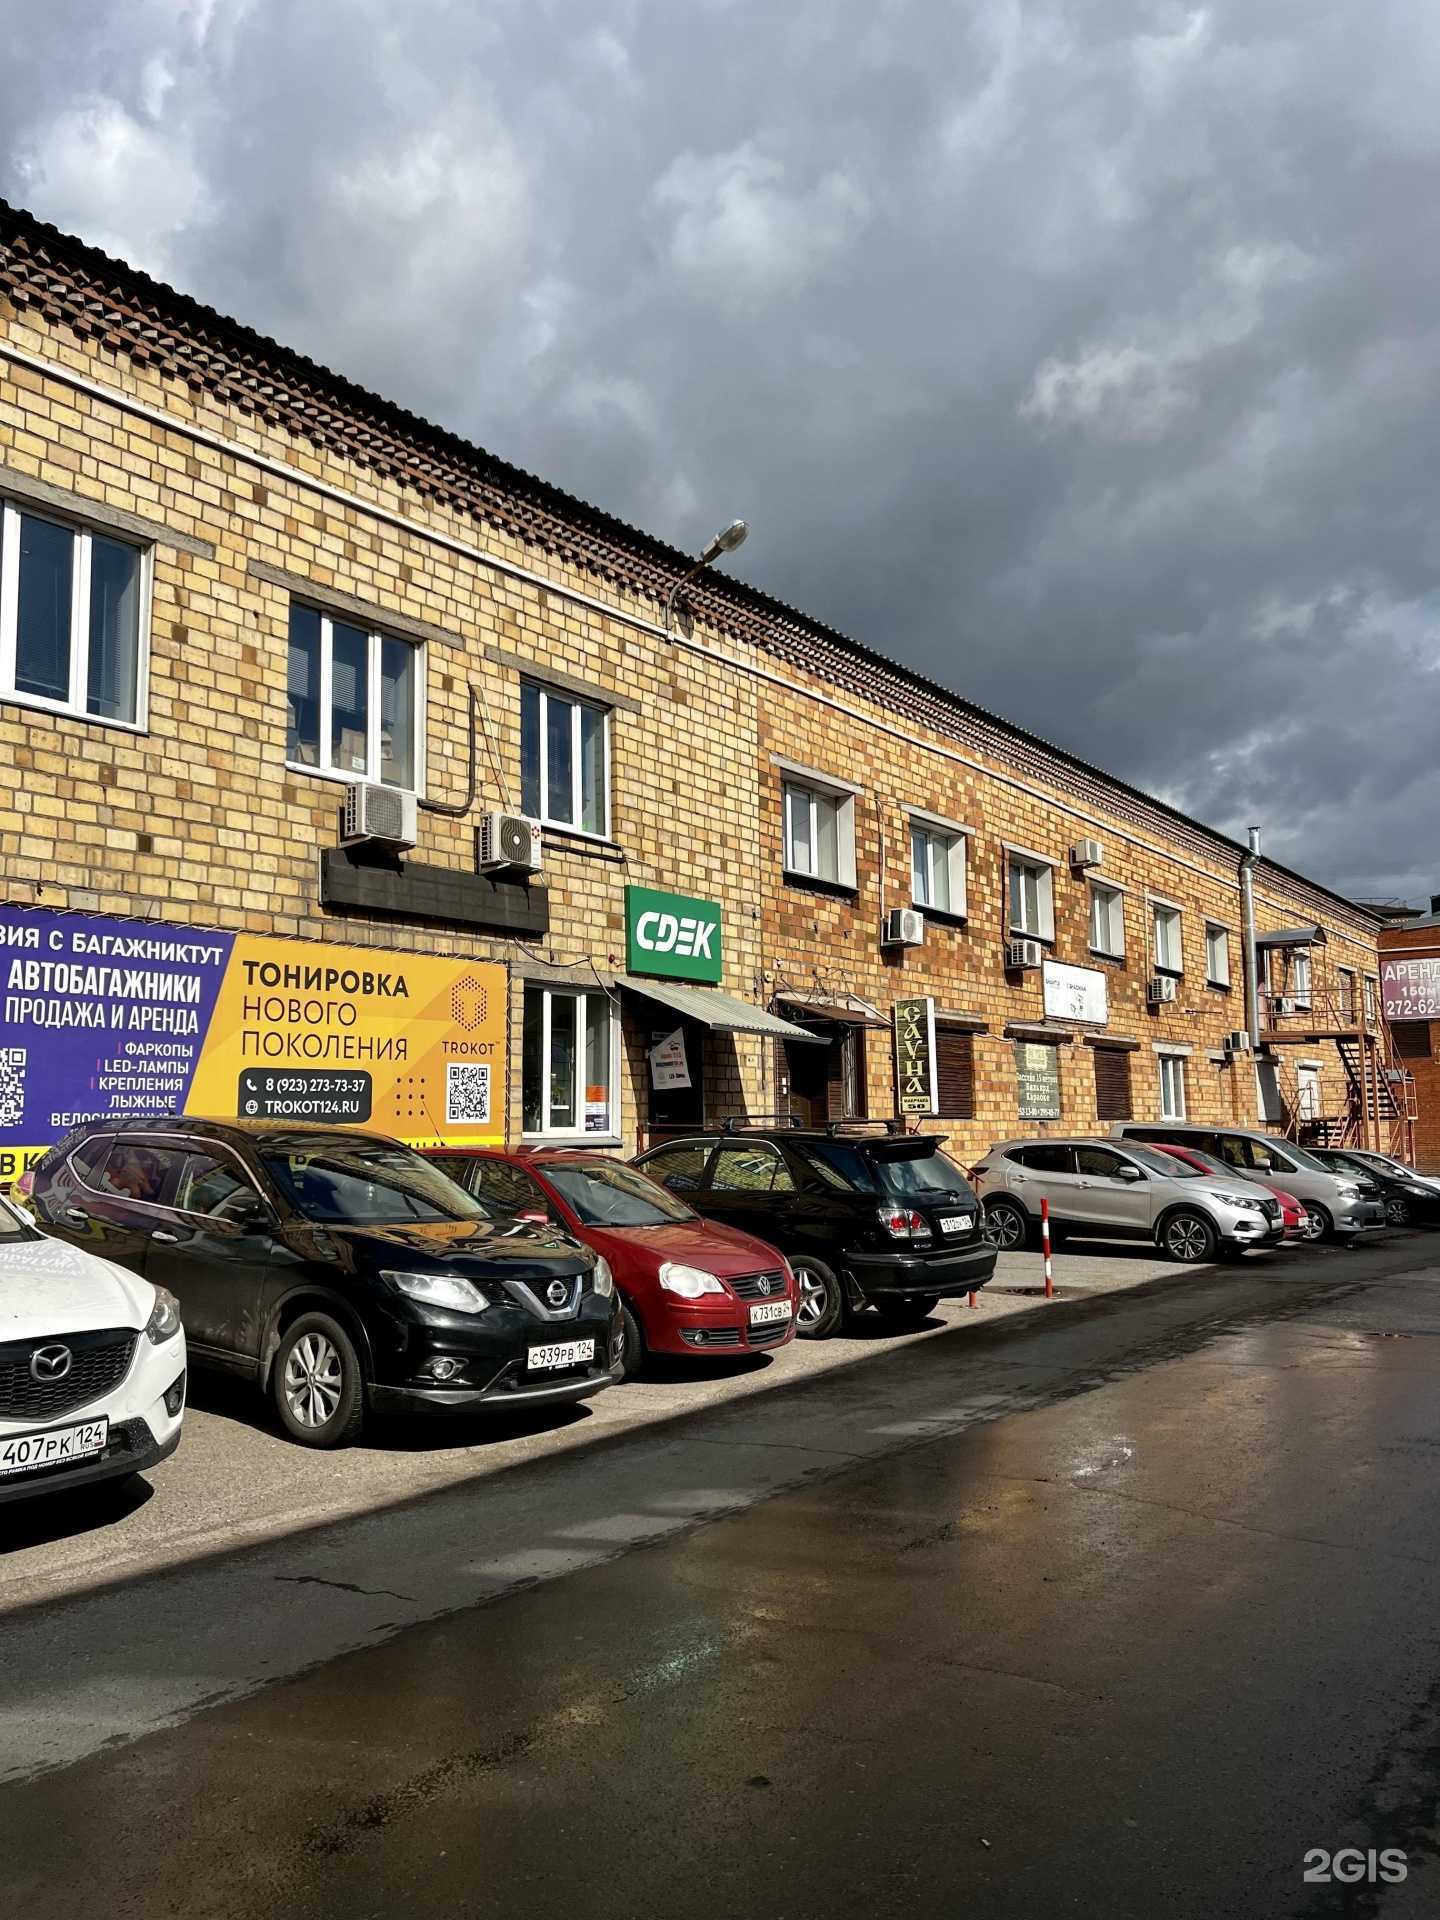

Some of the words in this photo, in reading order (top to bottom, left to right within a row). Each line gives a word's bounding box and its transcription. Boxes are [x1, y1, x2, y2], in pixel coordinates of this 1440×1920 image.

[49, 930, 64, 950] С
[72, 933, 223, 966] БАГАЖНИКТУТ
[636, 911, 716, 960] CDEK
[7, 959, 201, 1004] АВТОБАГАЖНИКИ
[242, 960, 409, 998] ТОНИРОВКА
[5, 997, 105, 1028] ПРОДАЖА
[110, 1004, 124, 1030] И
[128, 1005, 199, 1036] АРЕНДА
[243, 995, 357, 1026] НОВОГО
[125, 1042, 193, 1057] ФАРКОПЫ
[242, 1031, 408, 1061] ПОКОЛЕНИЯ
[442, 1041, 495, 1055] TROKOT
[104, 1060, 189, 1074] LED-ЛАМПЫ
[99, 1077, 183, 1091] КРЕПЛЕНИЯ
[265, 1078, 274, 1092] 8
[276, 1079, 308, 1094] (923)
[310, 1079, 366, 1092] 273-73-37
[109, 1095, 176, 1108] ЛЫЖНЫЕ
[265, 1100, 359, 1114] TROKOT124.RU
[533, 1347, 573, 1365] С939РВ
[577, 1341, 592, 1354] 124
[3, 1437, 71, 1465] 407РК
[76, 1424, 101, 1444] 124
